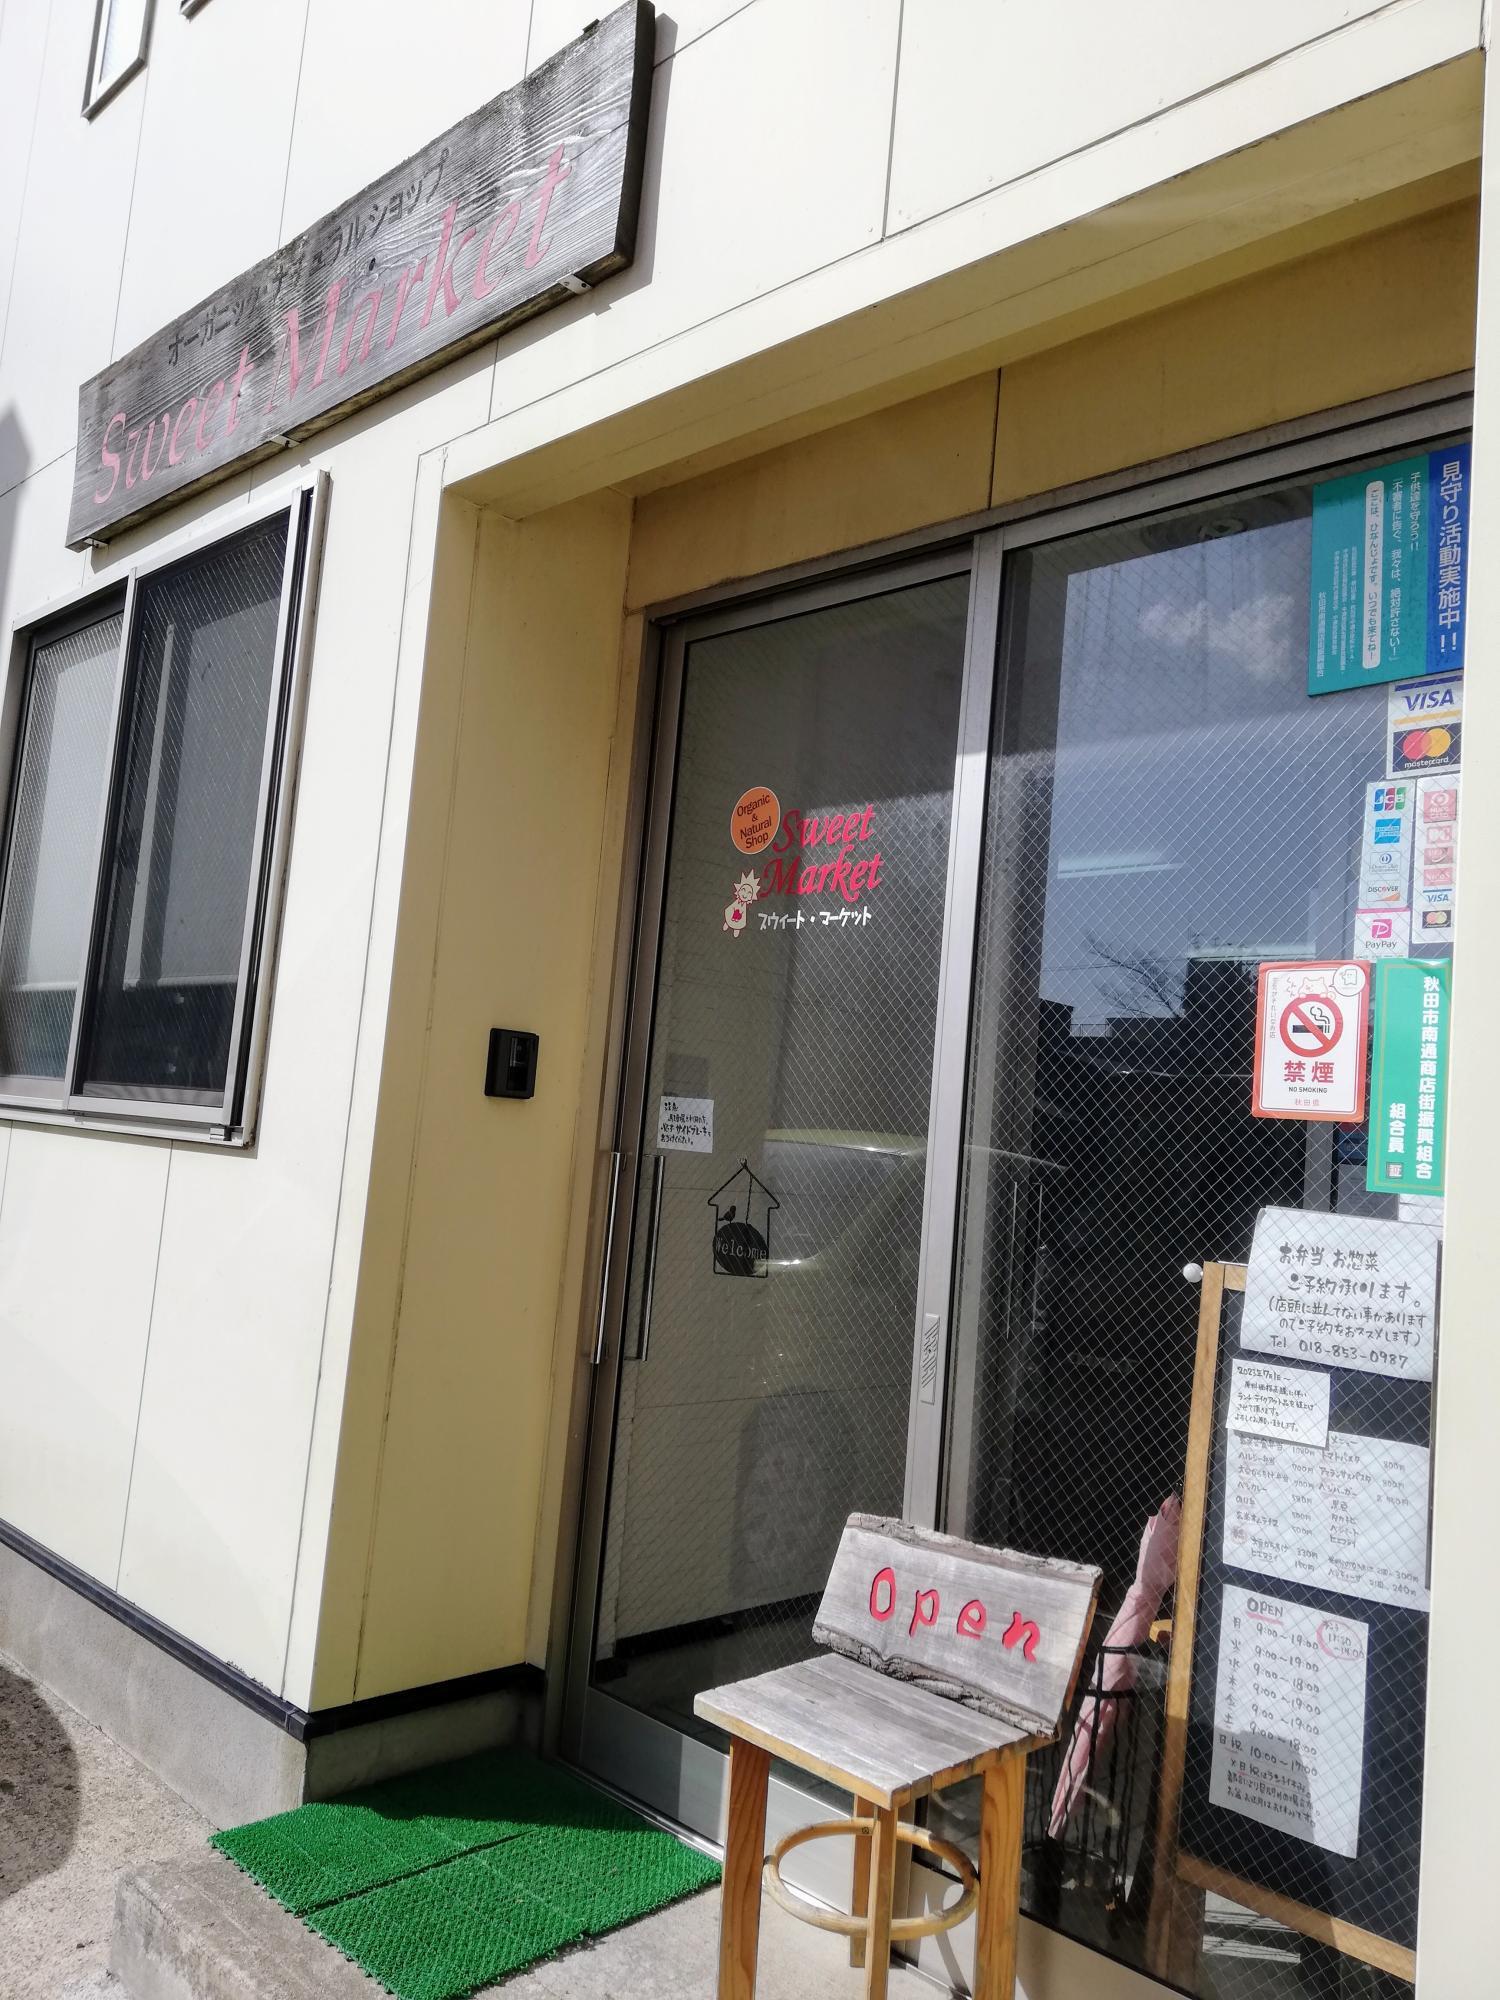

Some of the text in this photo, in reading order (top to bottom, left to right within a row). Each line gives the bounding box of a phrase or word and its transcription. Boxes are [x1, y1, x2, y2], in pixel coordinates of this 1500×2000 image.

[94, 144, 572, 504] Sweet Market
[1402, 689, 1455, 711] VISA
[1404, 756, 1449, 769] mastercard
[736, 794, 770, 817] Organic
[740, 817, 772, 840] Natural
[772, 803, 876, 852] Sweet
[745, 832, 769, 848] Shop
[758, 844, 883, 903] Market
[1368, 885, 1399, 893] DISCOVER
[1427, 893, 1449, 903] VISA
[1365, 940, 1397, 950] PayPay
[1284, 1060, 1335, 1084] 禁煙
[1416, 976, 1440, 1180] 秋田市南通商店街振興組合
[1299, 1086, 1328, 1094] SMOKING
[1388, 1102, 1406, 1154] 組合員
[1270, 1335, 1408, 1369] Tel 018-853-0987
[869, 1566, 1041, 1664] Open
[1247, 1597, 1284, 1618] OPEN
